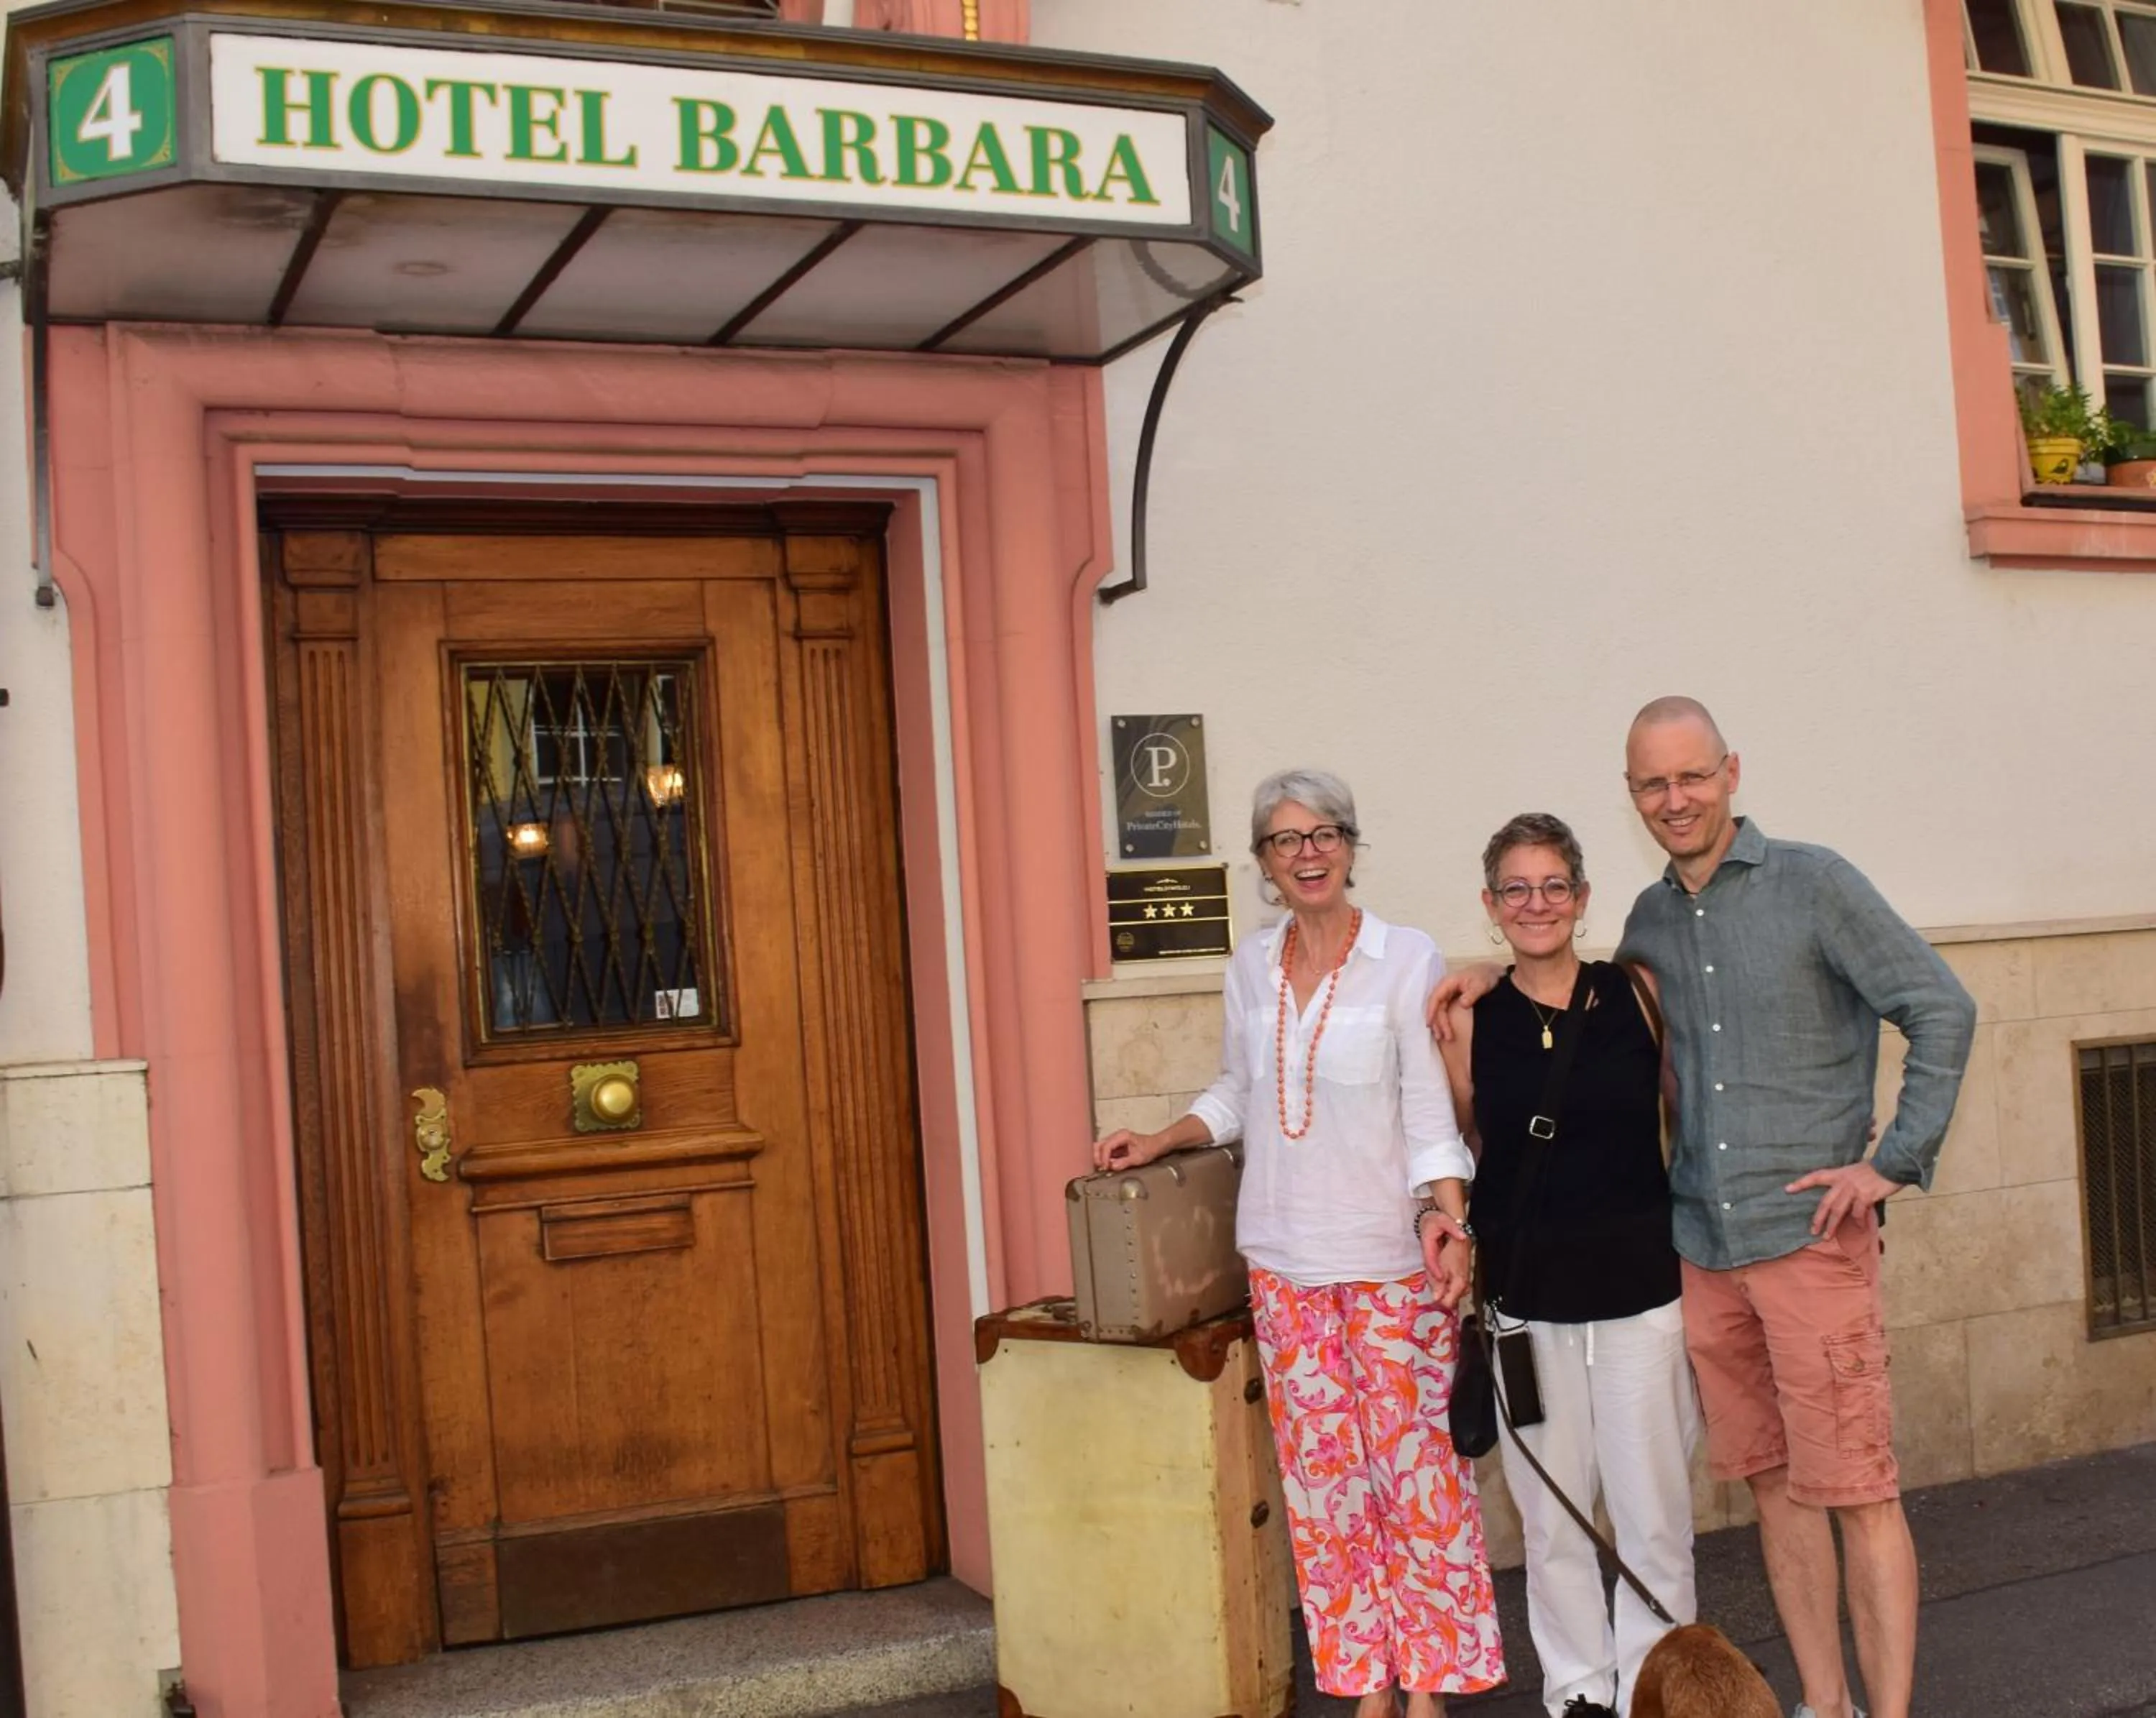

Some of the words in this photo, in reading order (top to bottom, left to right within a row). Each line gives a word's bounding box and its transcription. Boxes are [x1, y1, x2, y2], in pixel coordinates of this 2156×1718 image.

[78, 62, 142, 162] 4
[253, 65, 639, 170] HOTEL
[671, 95, 1161, 208] BARBARA
[1218, 155, 1240, 233] 4
